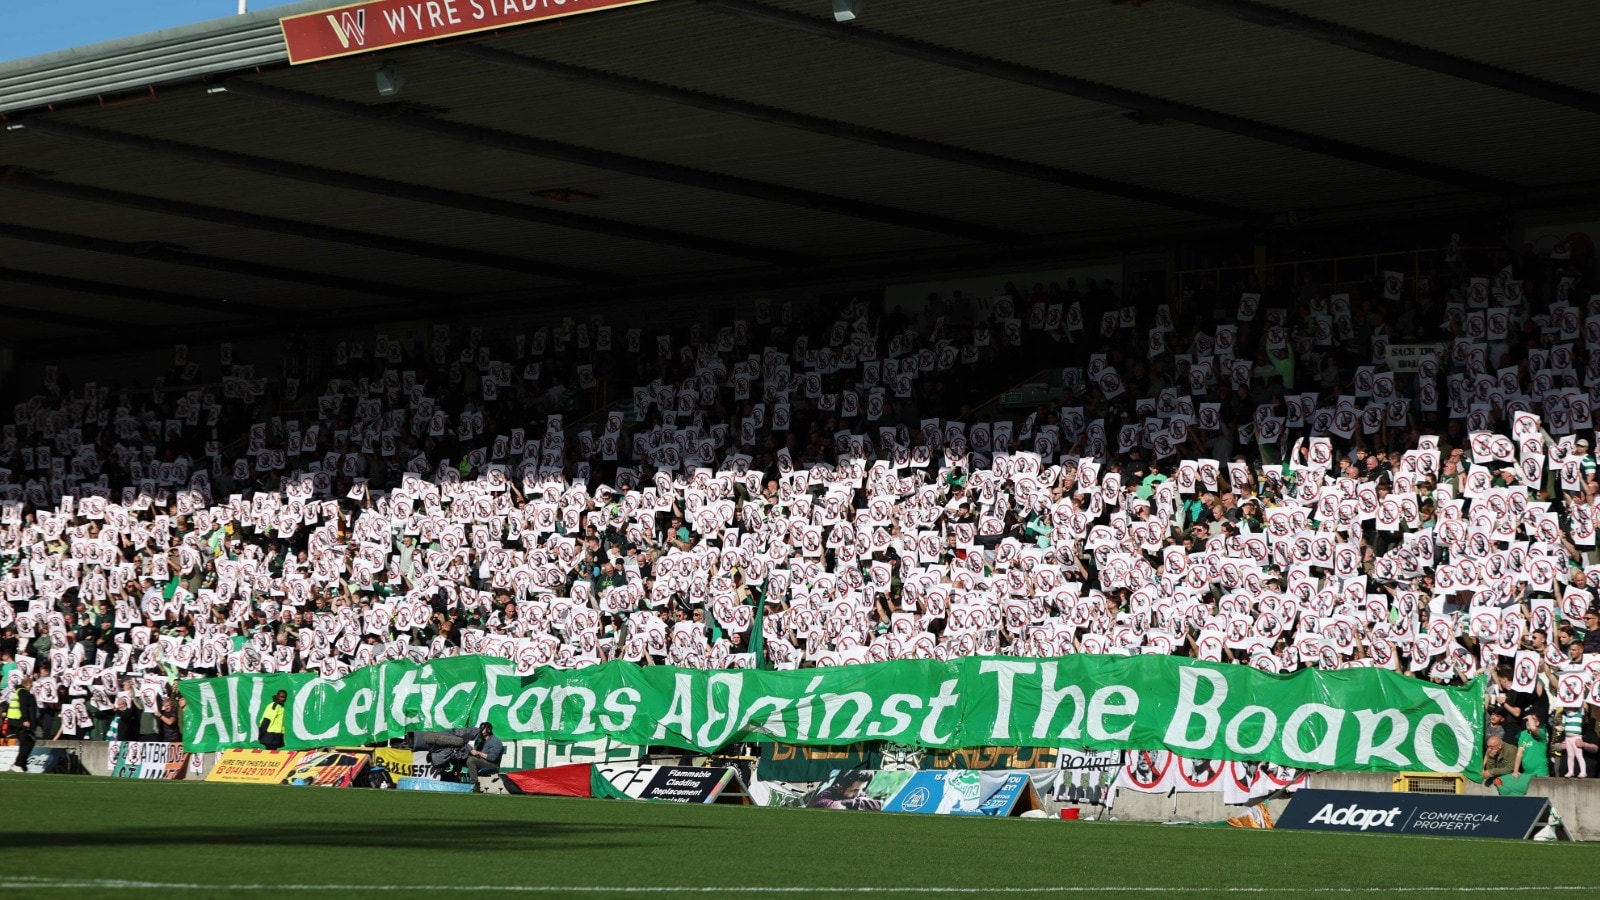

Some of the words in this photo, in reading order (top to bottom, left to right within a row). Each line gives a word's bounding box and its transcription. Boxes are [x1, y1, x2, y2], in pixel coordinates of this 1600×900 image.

[382, 0, 462, 35] WYRE
[1391, 347, 1416, 357] SACK
[192, 676, 264, 744] All
[292, 664, 477, 740] Celtic
[476, 664, 641, 735] Fans
[979, 660, 1138, 740] The
[1163, 666, 1475, 774] Board
[226, 766, 243, 775] 0141
[241, 767, 258, 776] 429
[257, 768, 276, 776] 7070
[668, 769, 712, 778] Flammable
[665, 778, 701, 788] Cladding
[651, 787, 703, 796] Replacement
[1308, 803, 1402, 831] Adapt
[1419, 811, 1500, 823] COMMERCIAL
[1413, 821, 1480, 831] PROPERTY
